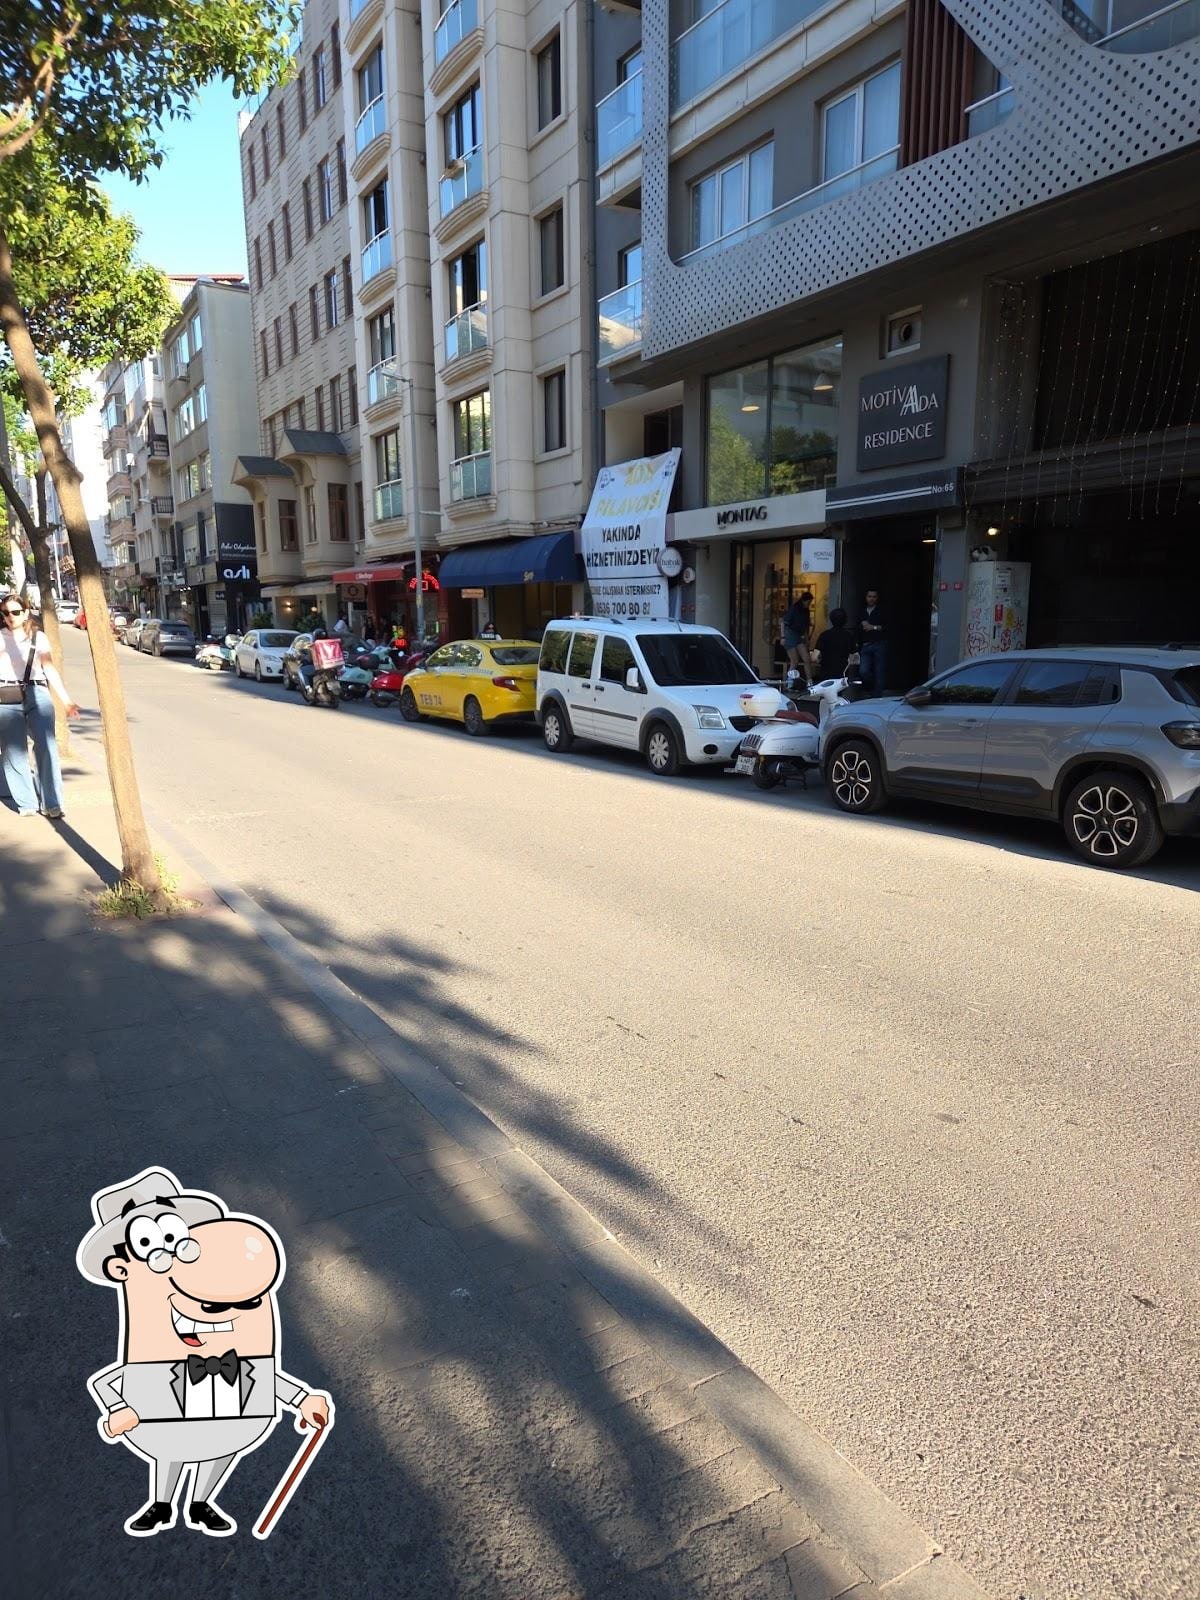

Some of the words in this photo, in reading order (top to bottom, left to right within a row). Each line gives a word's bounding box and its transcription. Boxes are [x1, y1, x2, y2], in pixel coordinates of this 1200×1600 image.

[864, 421, 934, 450] RESIDENCE
[716, 505, 768, 525] MONTAG
[602, 524, 641, 543] YAKINDA
[612, 601, 627, 615] 700
[628, 601, 640, 616] 80
